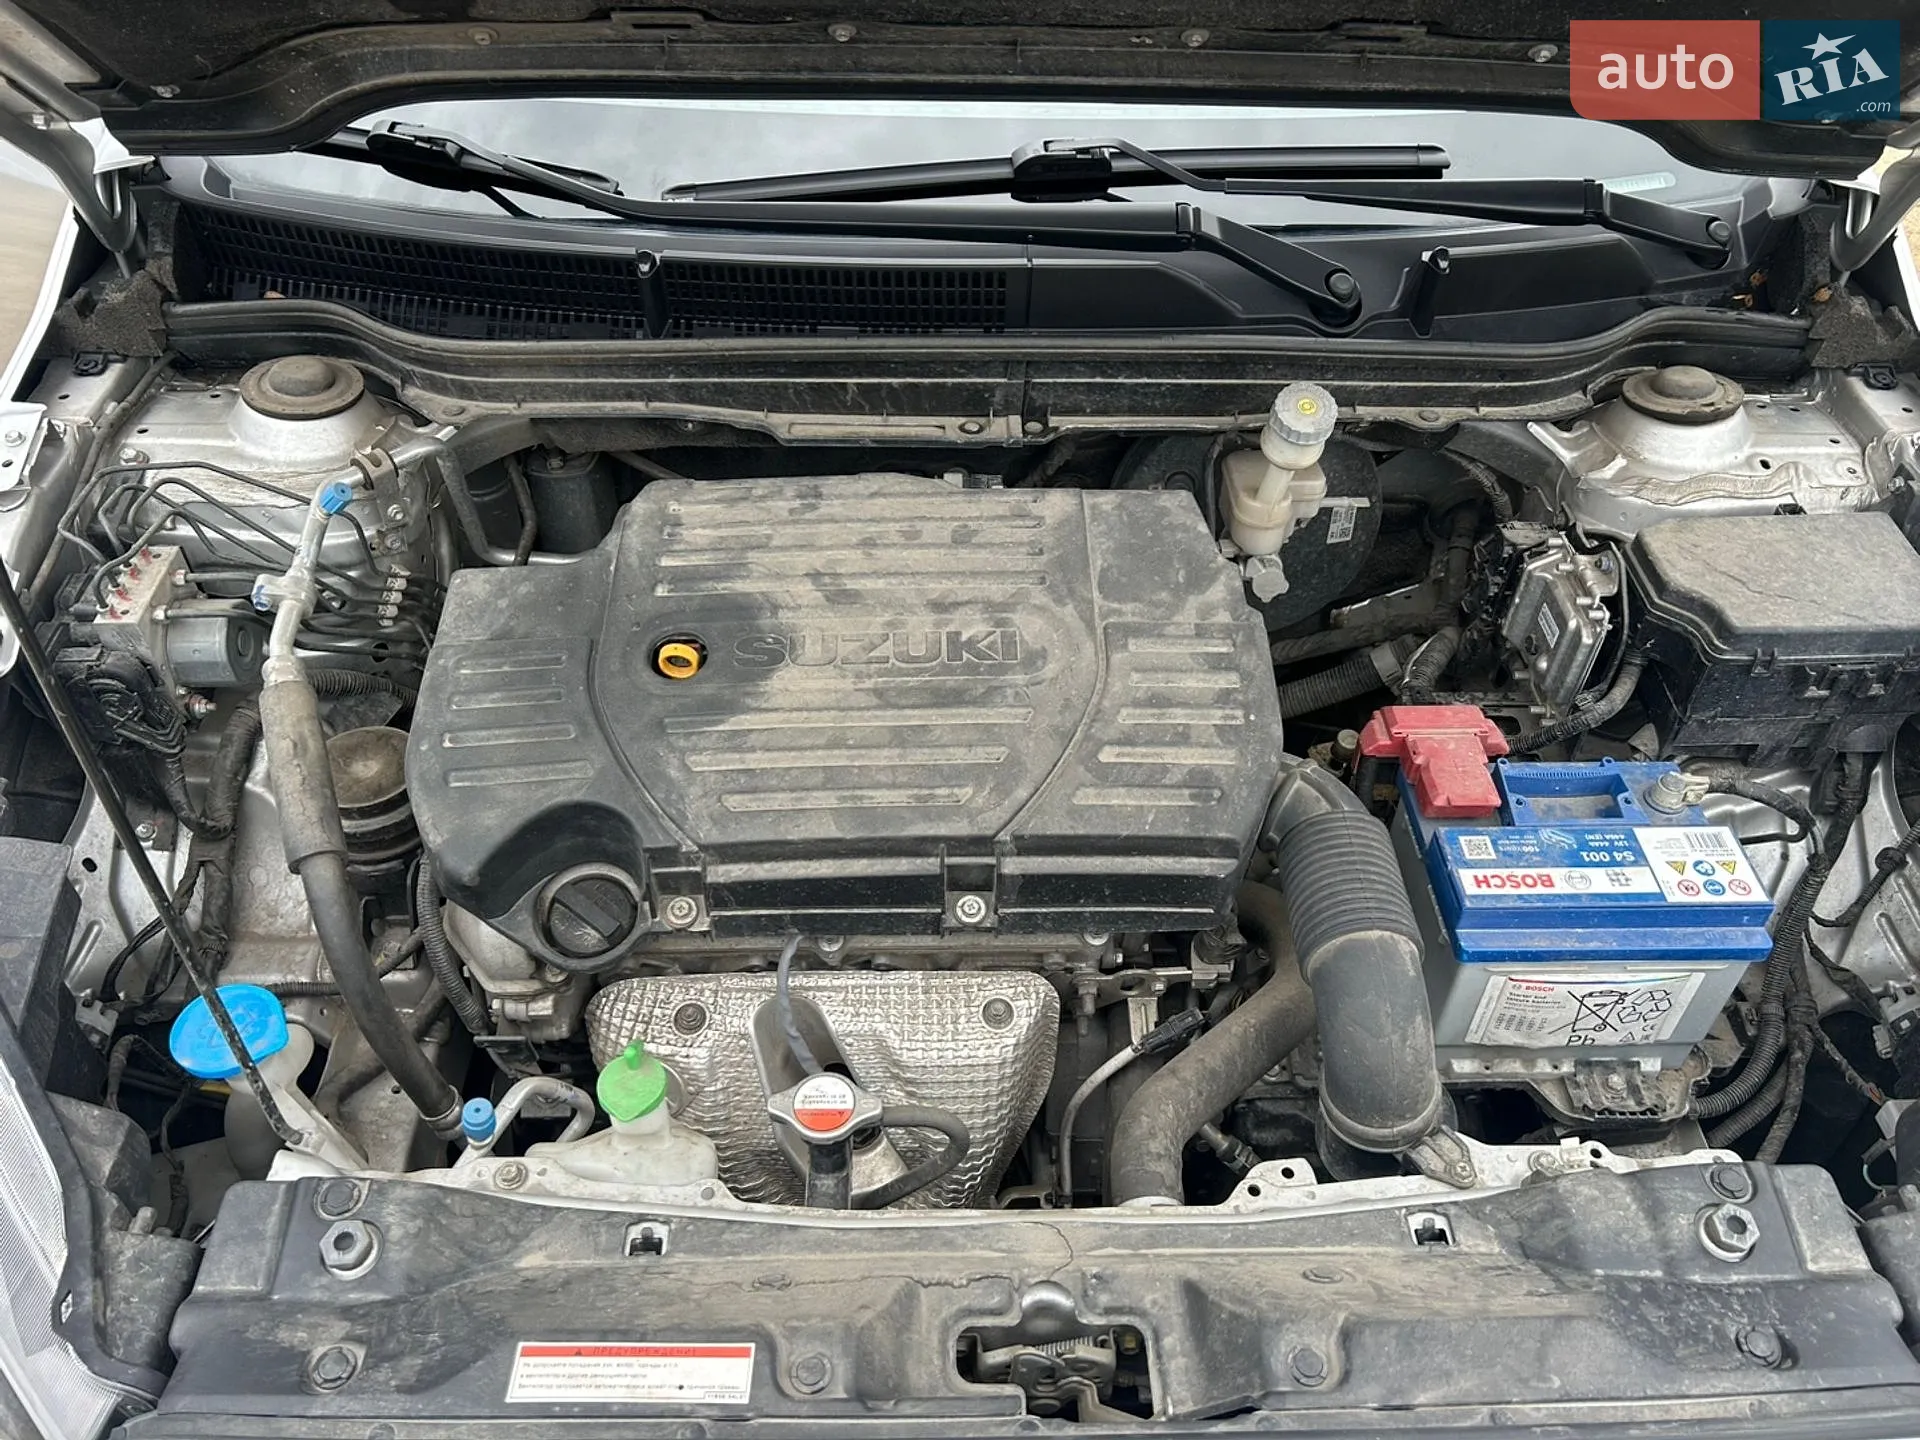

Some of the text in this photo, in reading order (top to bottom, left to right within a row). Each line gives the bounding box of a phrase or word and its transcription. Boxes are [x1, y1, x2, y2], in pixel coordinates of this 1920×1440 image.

[733, 629, 1021, 668] SUZUKI
[1580, 850, 1636, 863] S4 001
[1473, 874, 1556, 889] BOSCH
[1566, 1034, 1595, 1046] Pb
